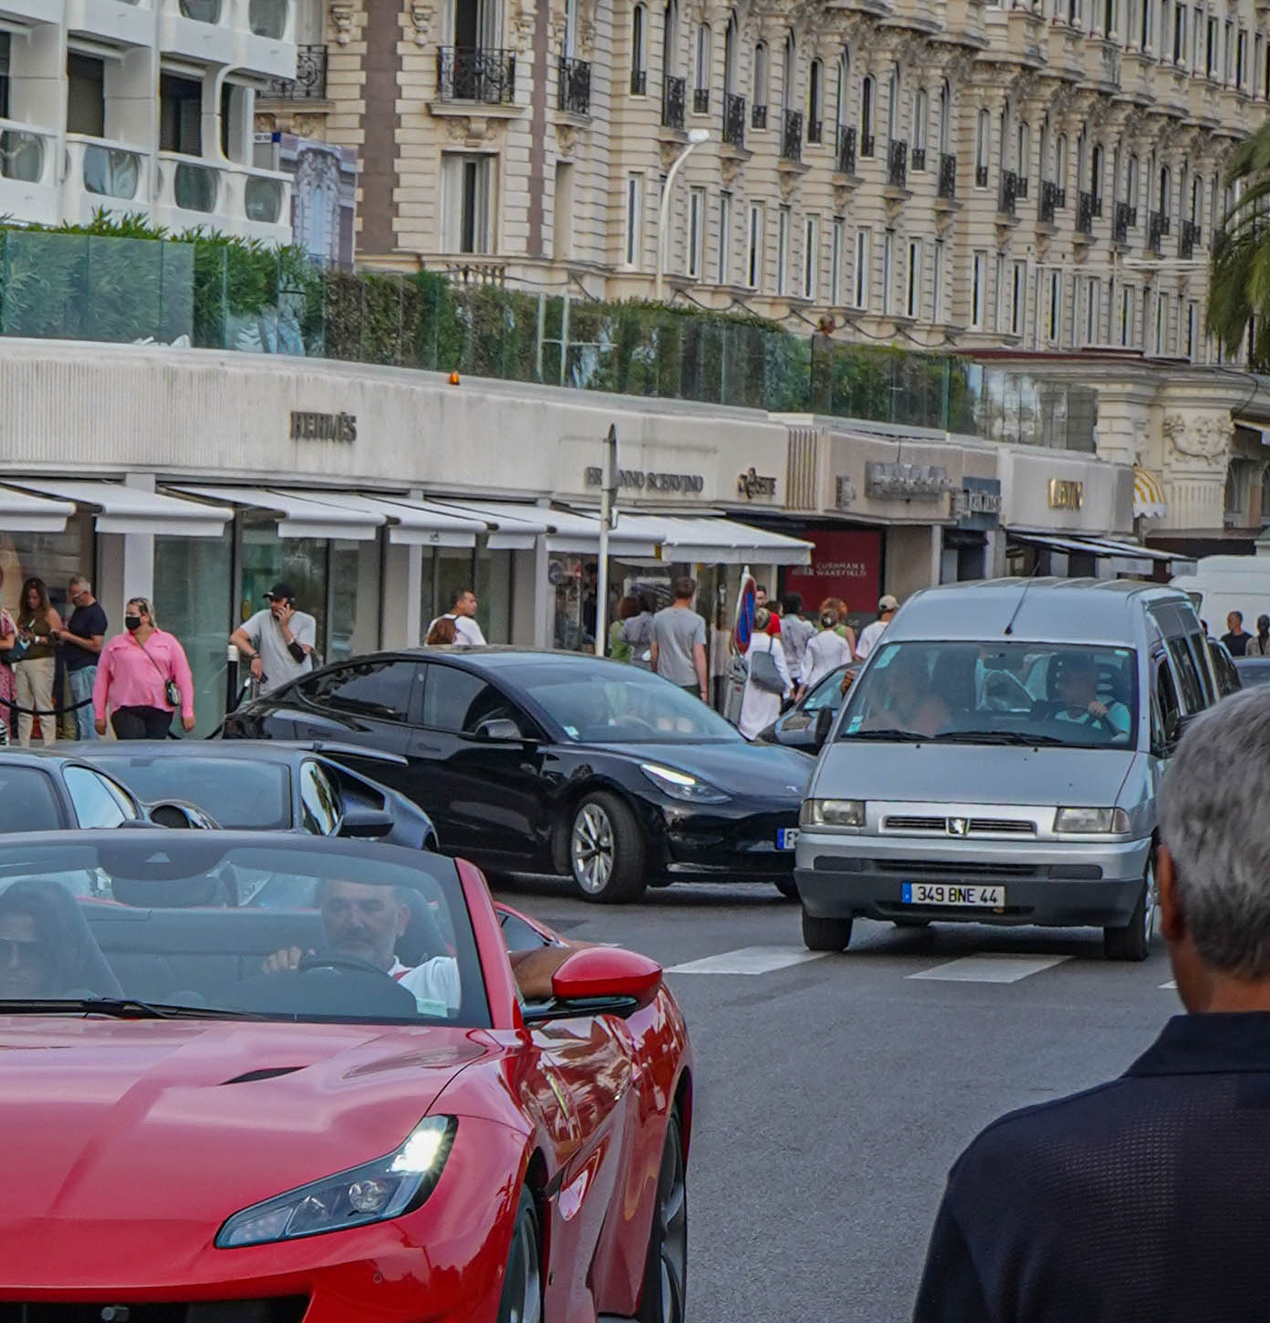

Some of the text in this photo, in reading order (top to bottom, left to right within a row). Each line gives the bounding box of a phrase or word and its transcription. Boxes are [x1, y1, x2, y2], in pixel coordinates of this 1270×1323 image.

[917, 885, 998, 904] 349 BNE 44
